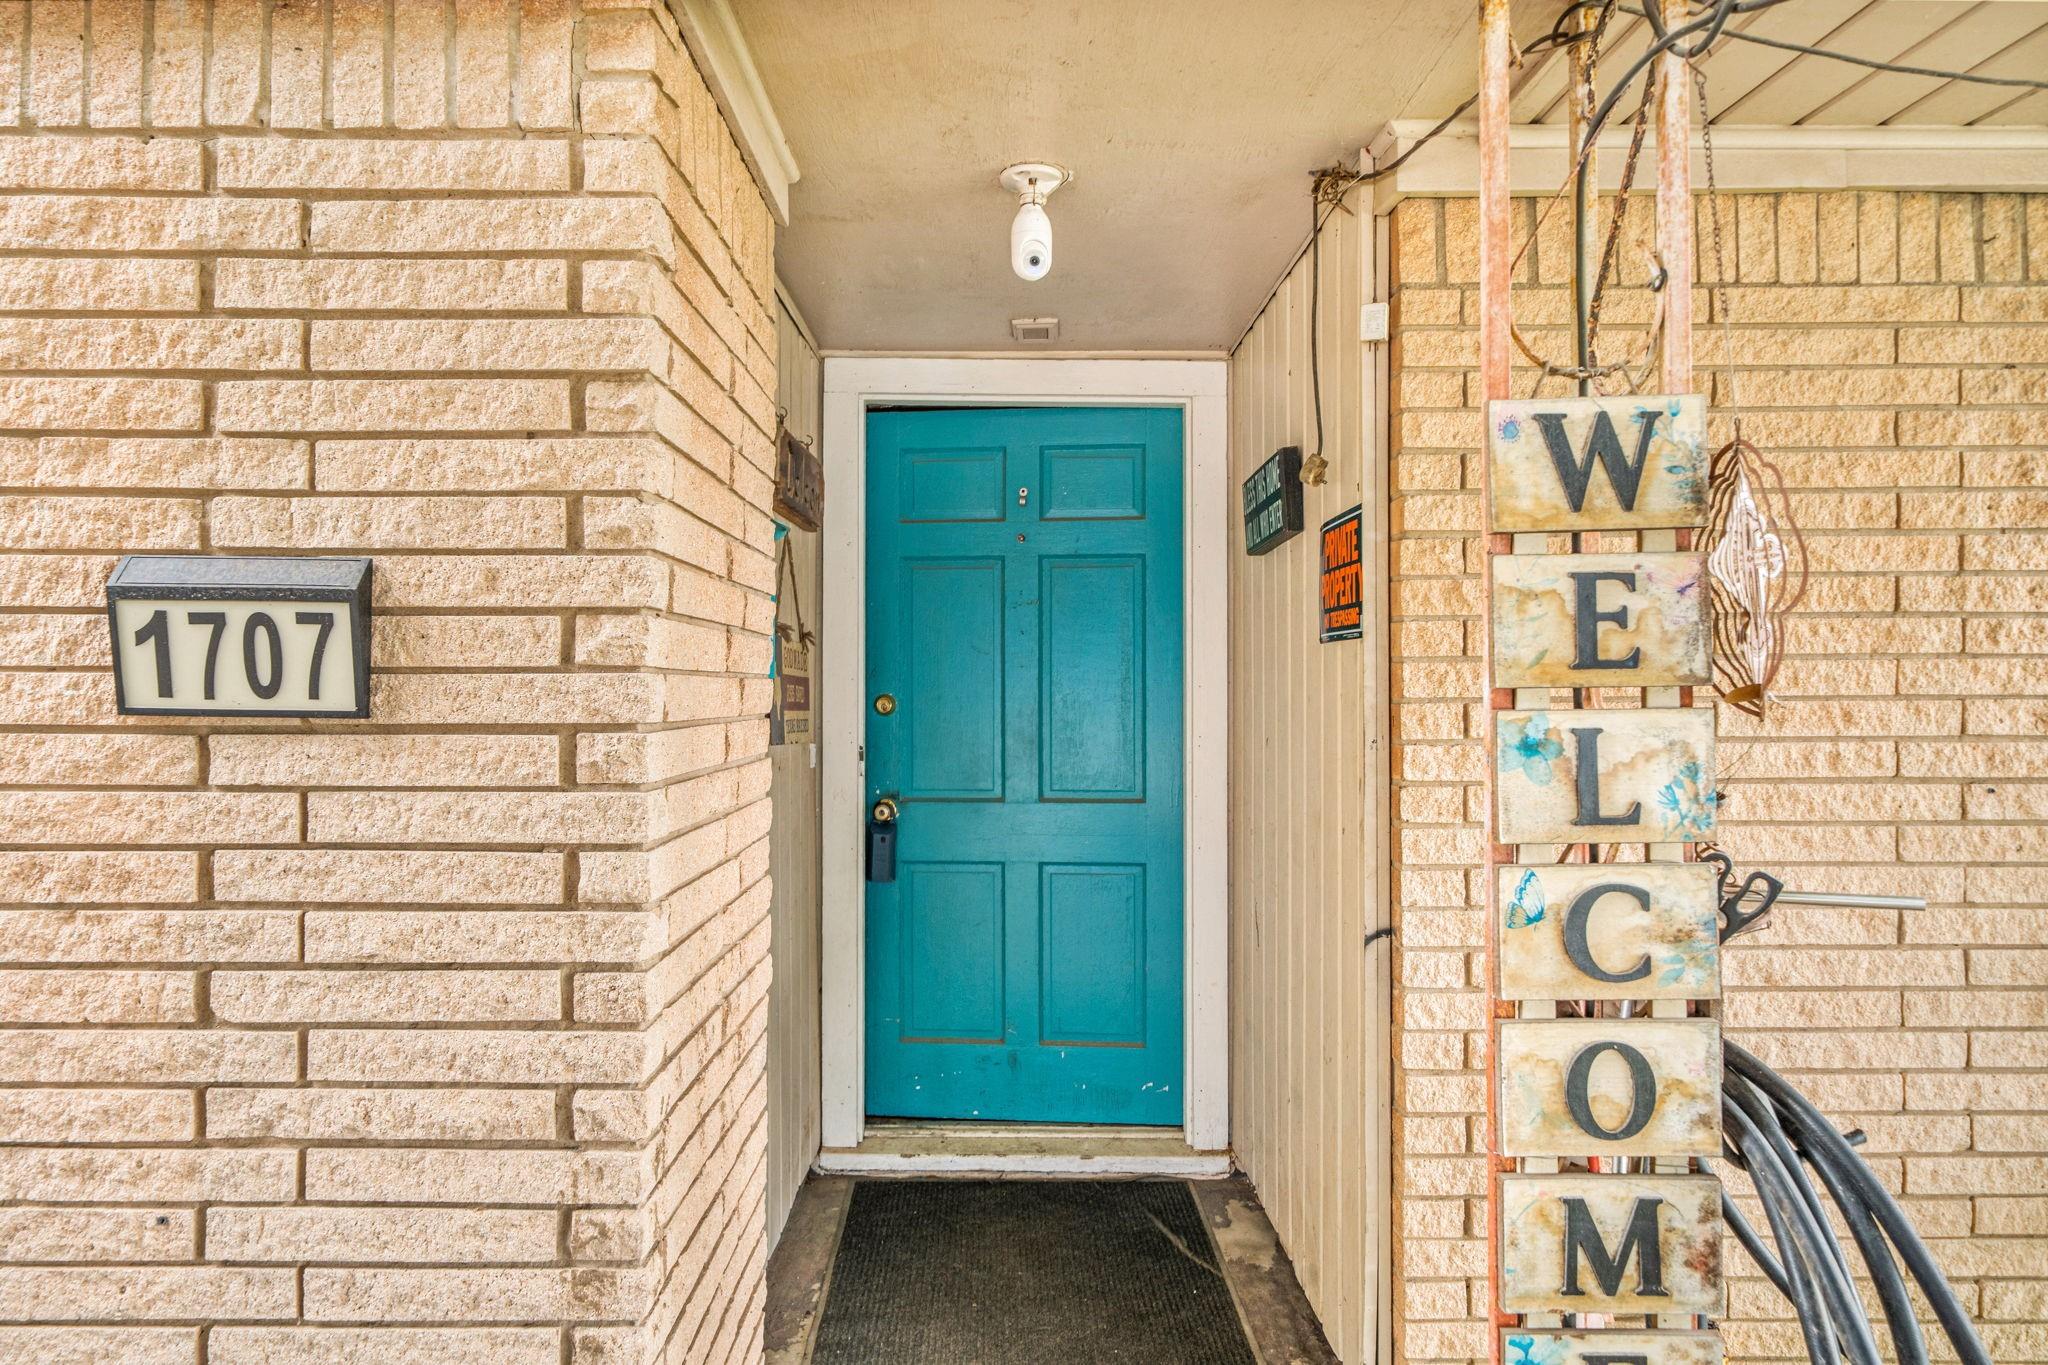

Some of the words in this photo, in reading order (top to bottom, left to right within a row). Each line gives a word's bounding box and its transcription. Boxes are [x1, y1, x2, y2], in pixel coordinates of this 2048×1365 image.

[1269, 498, 1284, 534] ENTER
[1324, 519, 1359, 570] PRIVATE
[1322, 562, 1364, 609] PROPERTY
[134, 610, 335, 701] 1707
[1532, 410, 1671, 1365] WELCOM
